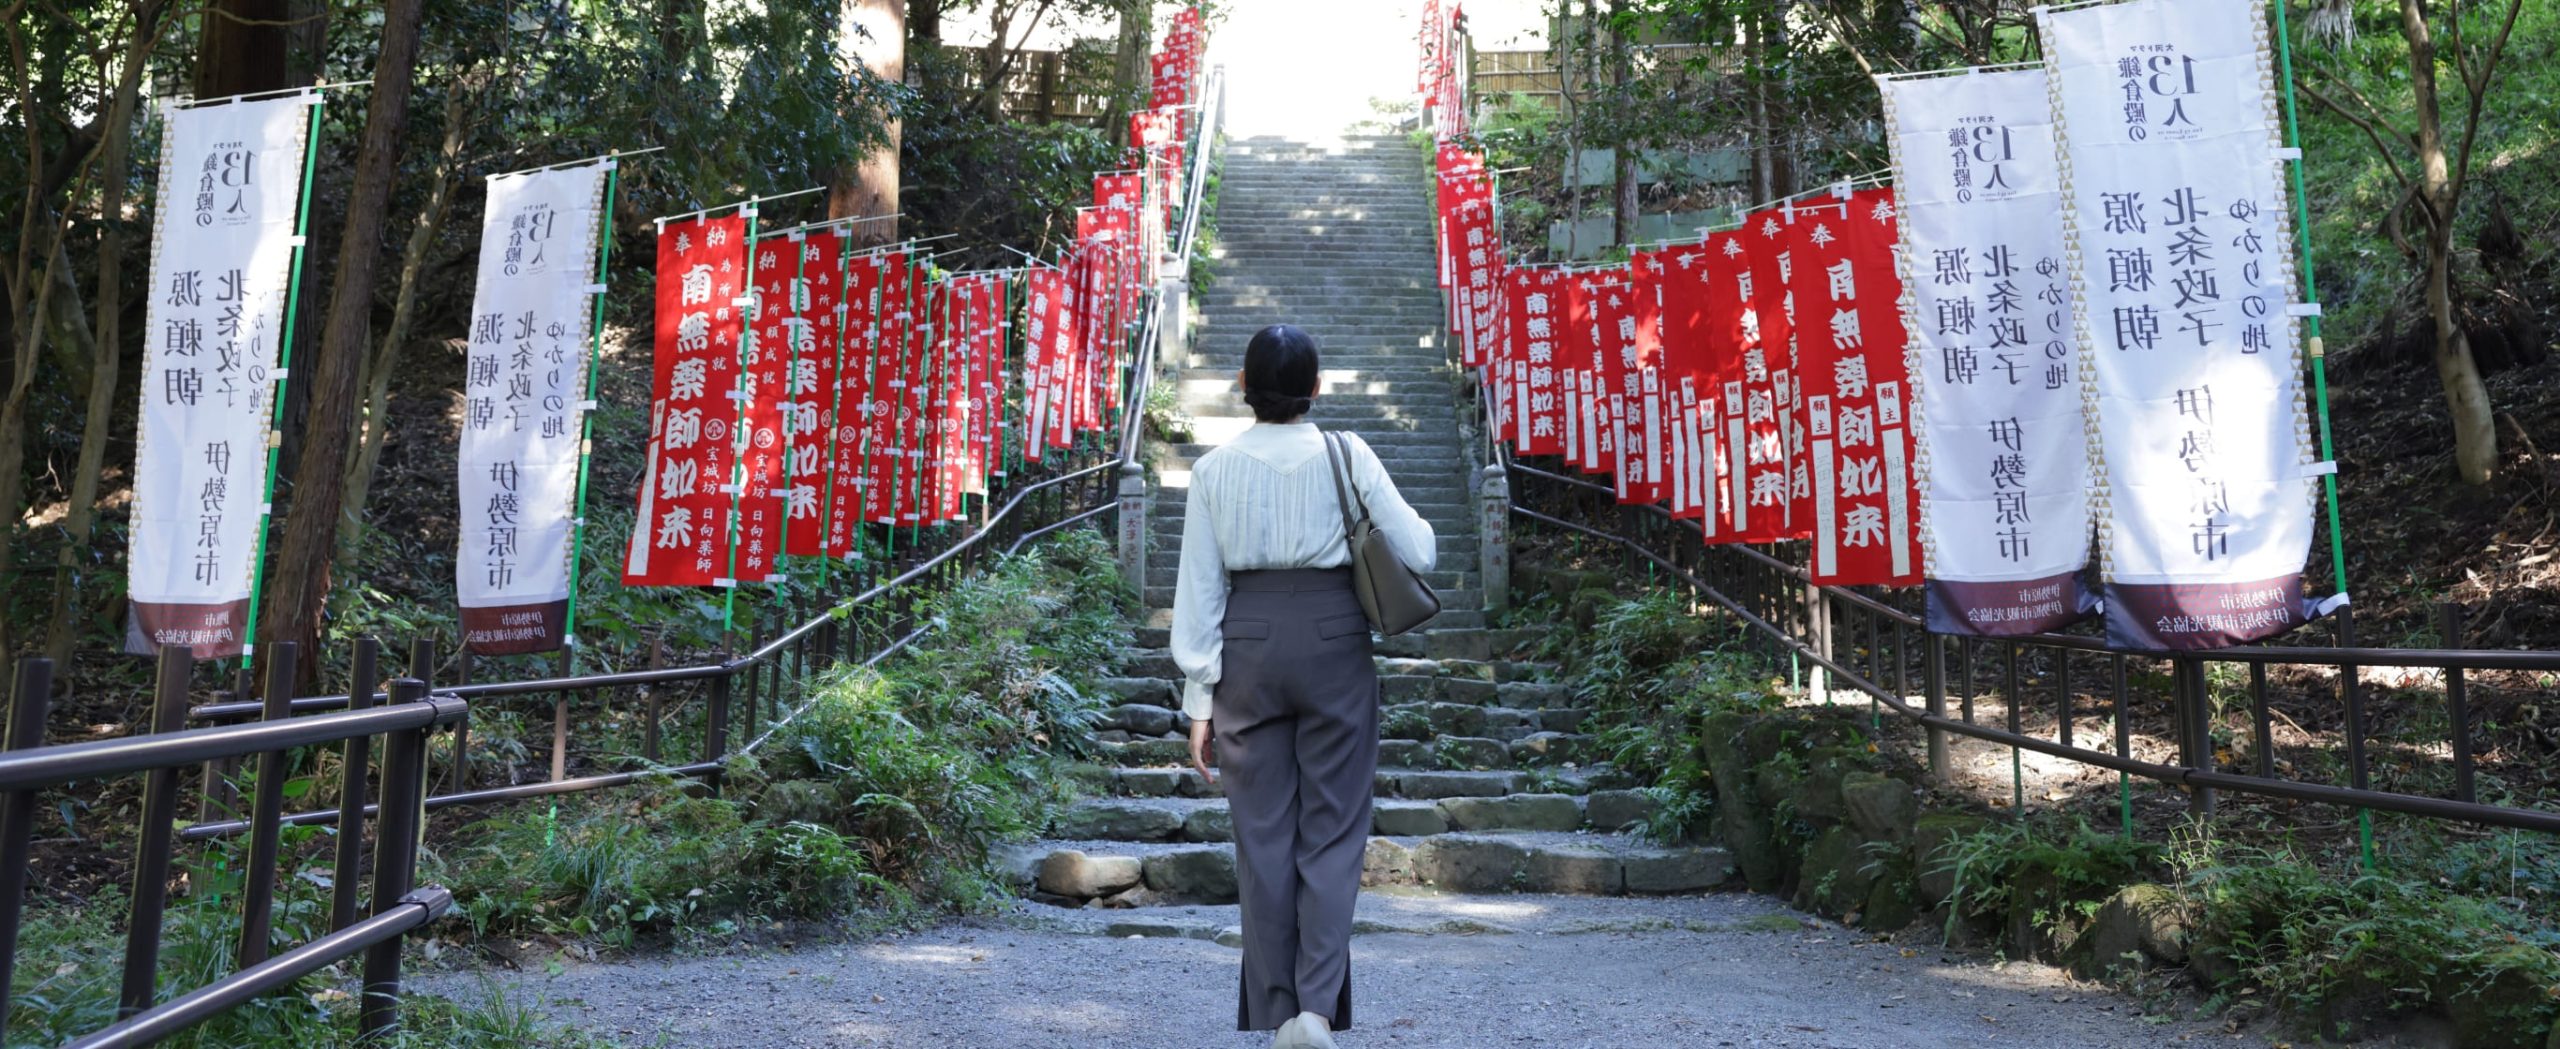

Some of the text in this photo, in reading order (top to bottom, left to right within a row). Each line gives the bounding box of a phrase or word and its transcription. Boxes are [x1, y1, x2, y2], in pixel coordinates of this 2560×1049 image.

[1761, 217, 1782, 240] 奉
[1810, 223, 1836, 249] 奉
[1871, 199, 1896, 226] 奉
[1723, 237, 1744, 260] 奉
[712, 258, 732, 370] 為所願成就
[762, 280, 781, 384] 為所願成就
[1525, 292, 1555, 437] 南無薬師如来
[656, 264, 714, 549] 南無薬師如来
[1812, 400, 1828, 432] 願主
[1880, 386, 1897, 421] 願主
[697, 446, 720, 572] 宝城坊 日向薬師
[747, 453, 769, 570] 宝城坊 日向薬師
